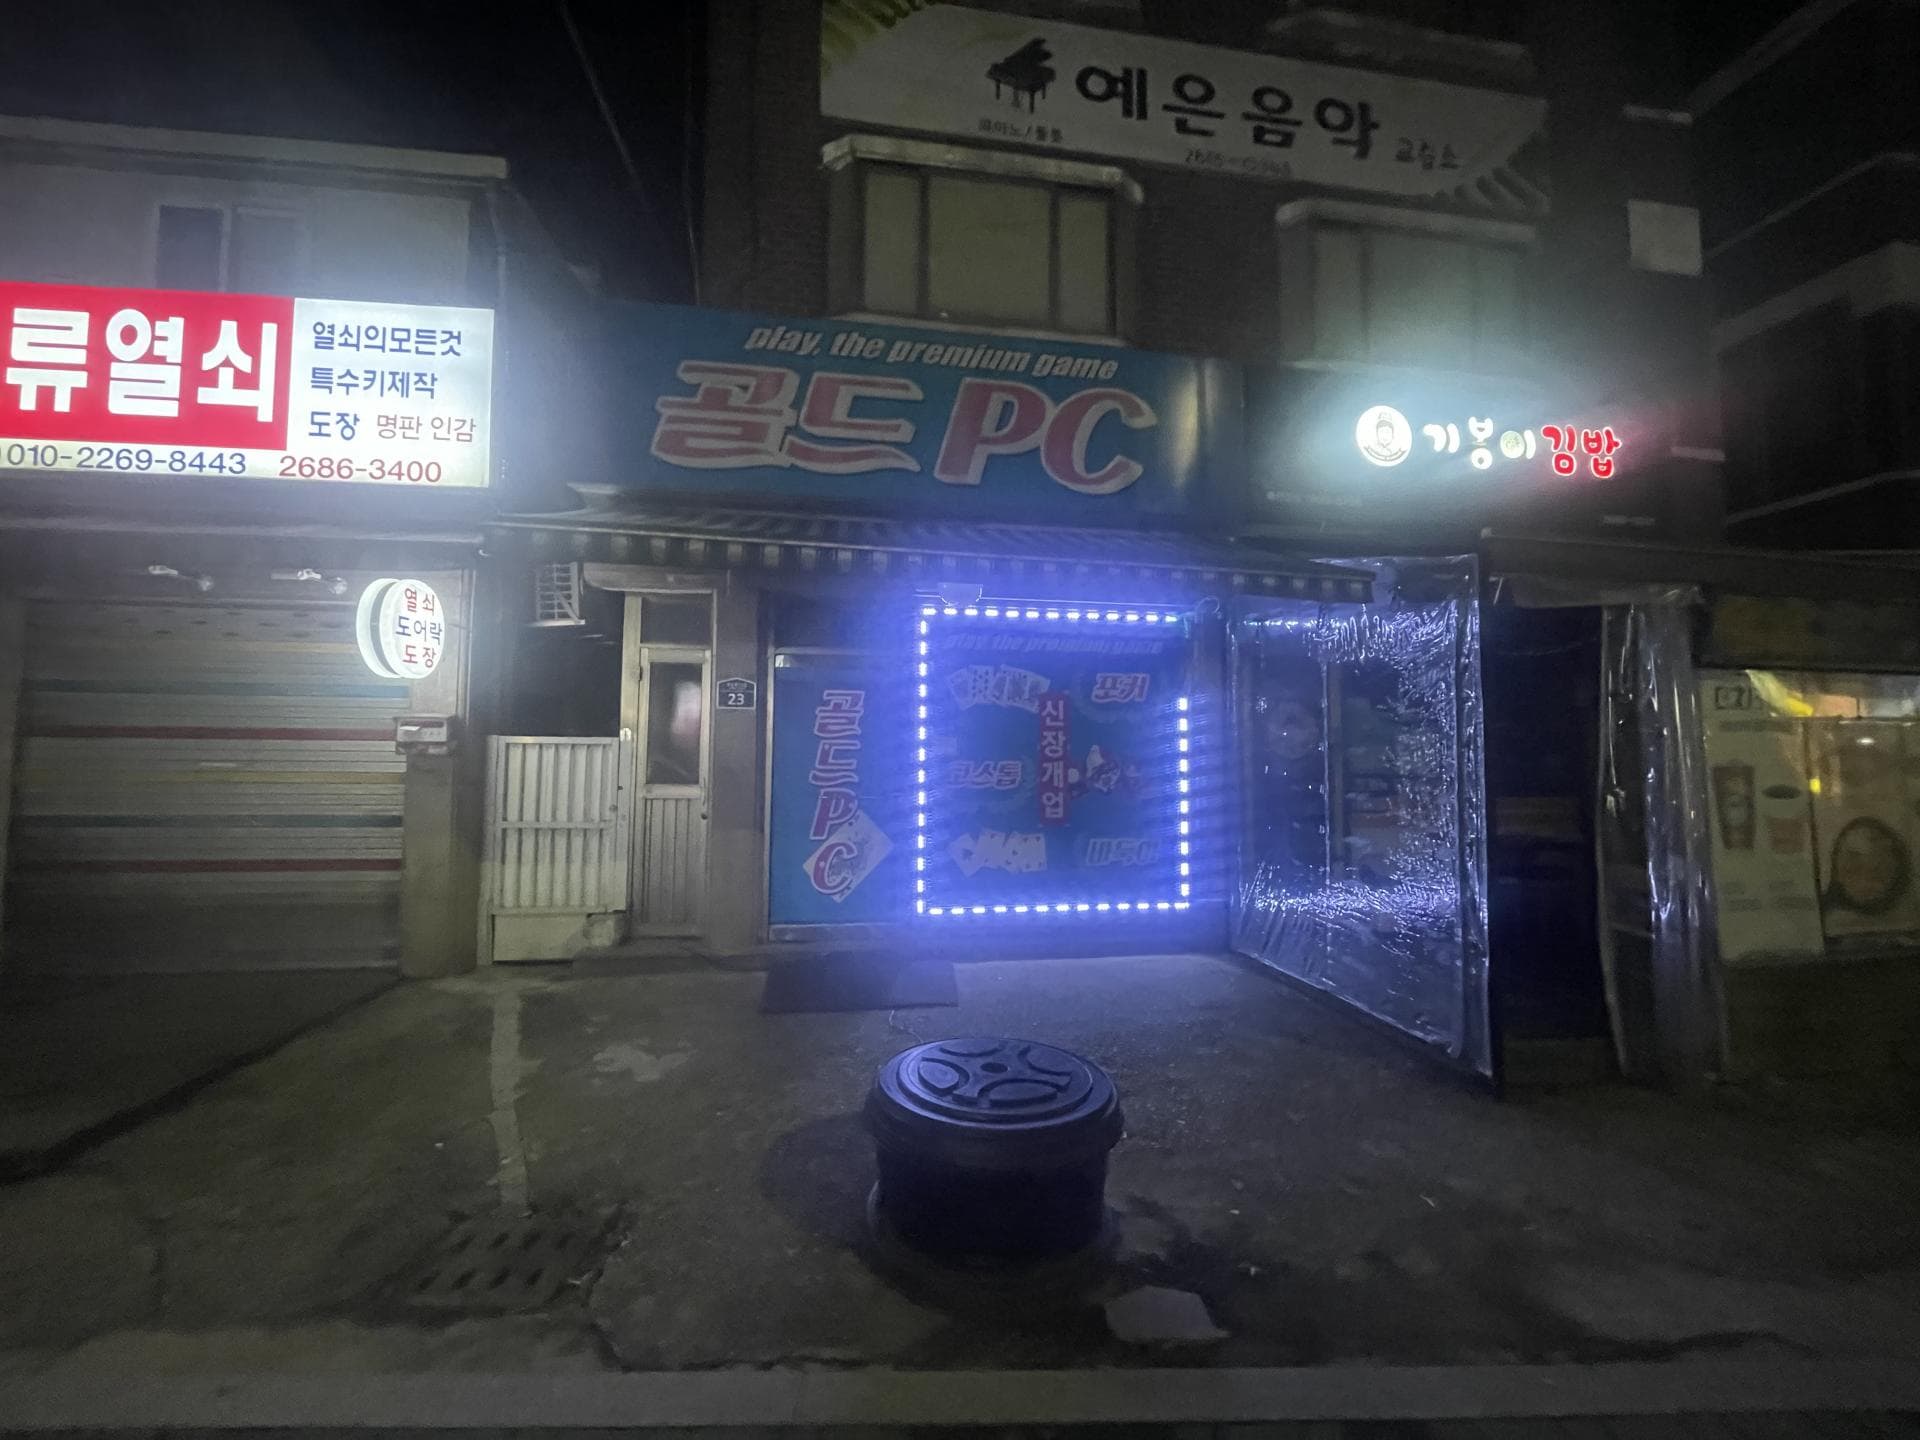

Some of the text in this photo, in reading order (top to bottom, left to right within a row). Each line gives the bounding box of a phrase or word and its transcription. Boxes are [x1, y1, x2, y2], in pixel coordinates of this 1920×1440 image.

[1076, 65, 1380, 160] 예은음악
[312, 321, 462, 357] 열쇠의모든것
[5, 307, 278, 422] 류열쇠
[829, 331, 882, 360] the
[886, 338, 1030, 374] premium
[1031, 351, 1118, 381] game
[310, 366, 438, 398] 특수키제작
[308, 410, 476, 443] 도장 명판 인감
[6, 443, 247, 474] 010-2269-8443
[279, 456, 442, 483] 2686-3400
[404, 587, 435, 616] 열쇠
[395, 615, 442, 645] 도어락
[402, 644, 437, 668] 도장
[727, 693, 745, 706] 23
[1041, 699, 1066, 818] 신장개업
